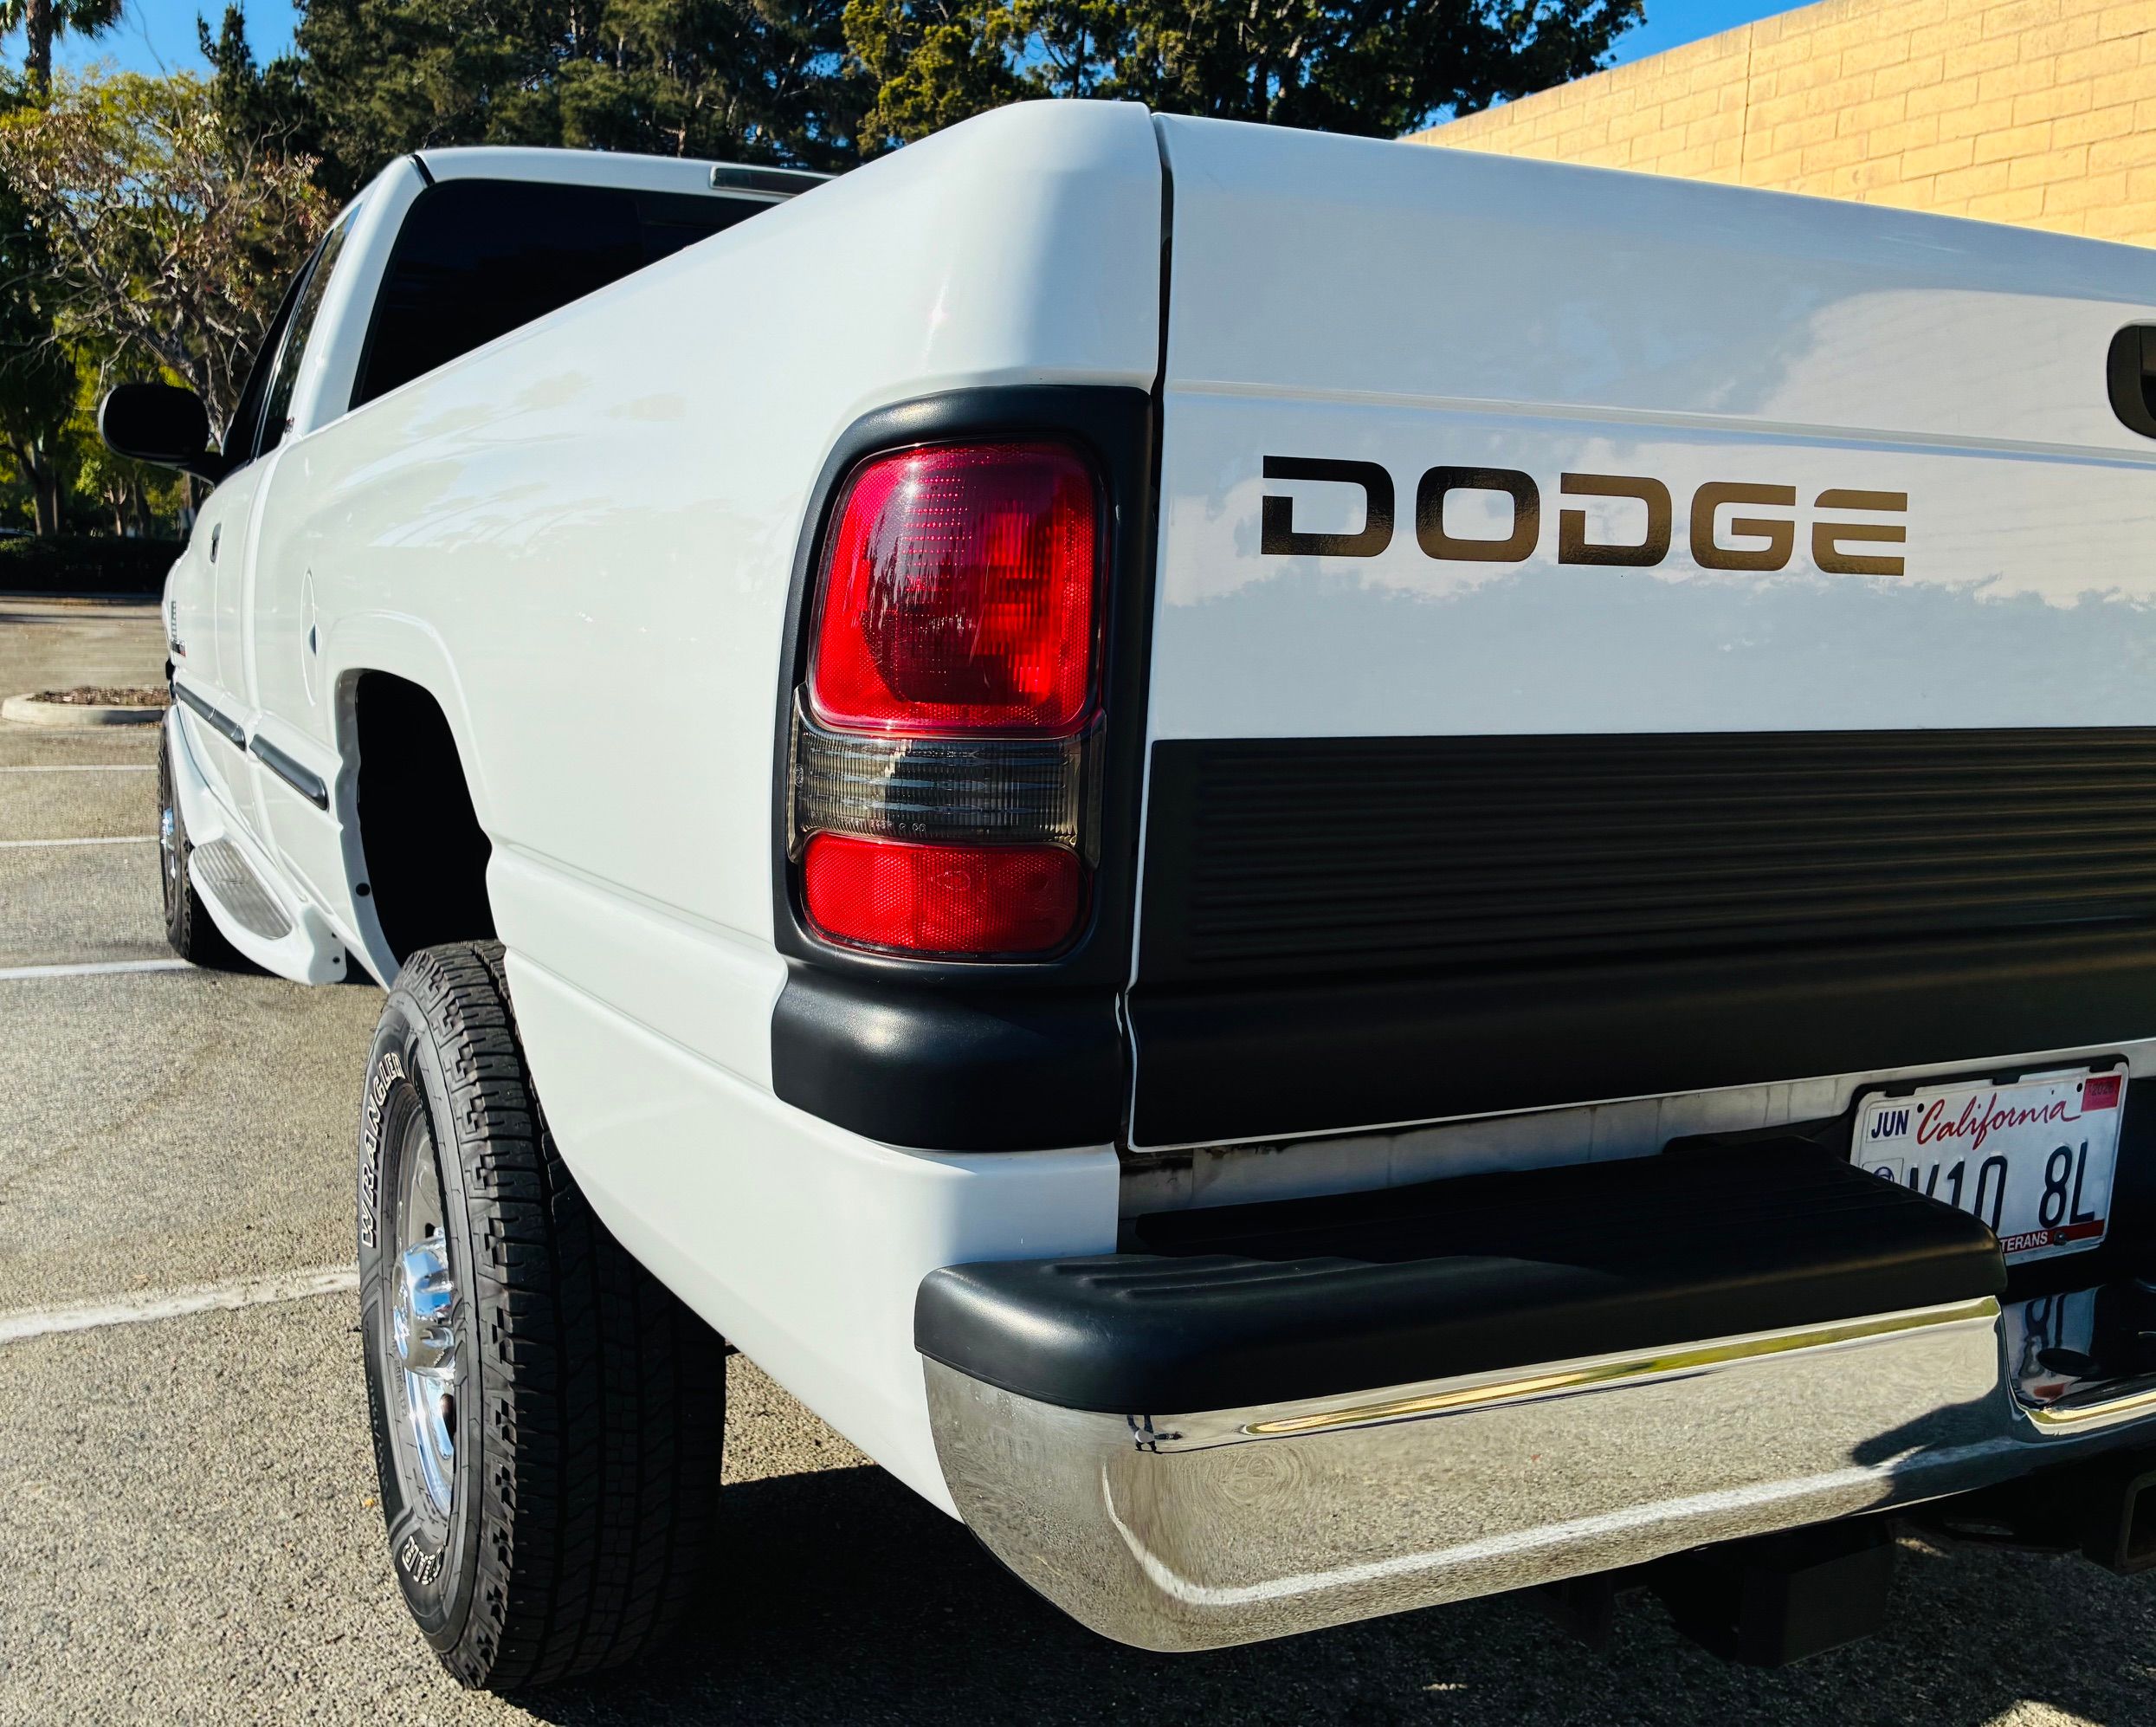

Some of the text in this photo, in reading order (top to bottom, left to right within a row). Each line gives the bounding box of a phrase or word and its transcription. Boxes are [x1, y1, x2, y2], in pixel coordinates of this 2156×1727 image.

[1262, 455, 1908, 577] DODGE
[362, 1051, 406, 1248] WRANGLER
[1871, 1109, 1910, 1139] JUN
[1916, 1092, 2082, 1151] California
[2038, 1141, 2095, 1229] 8L
[2000, 1231, 2049, 1252] TERANS
